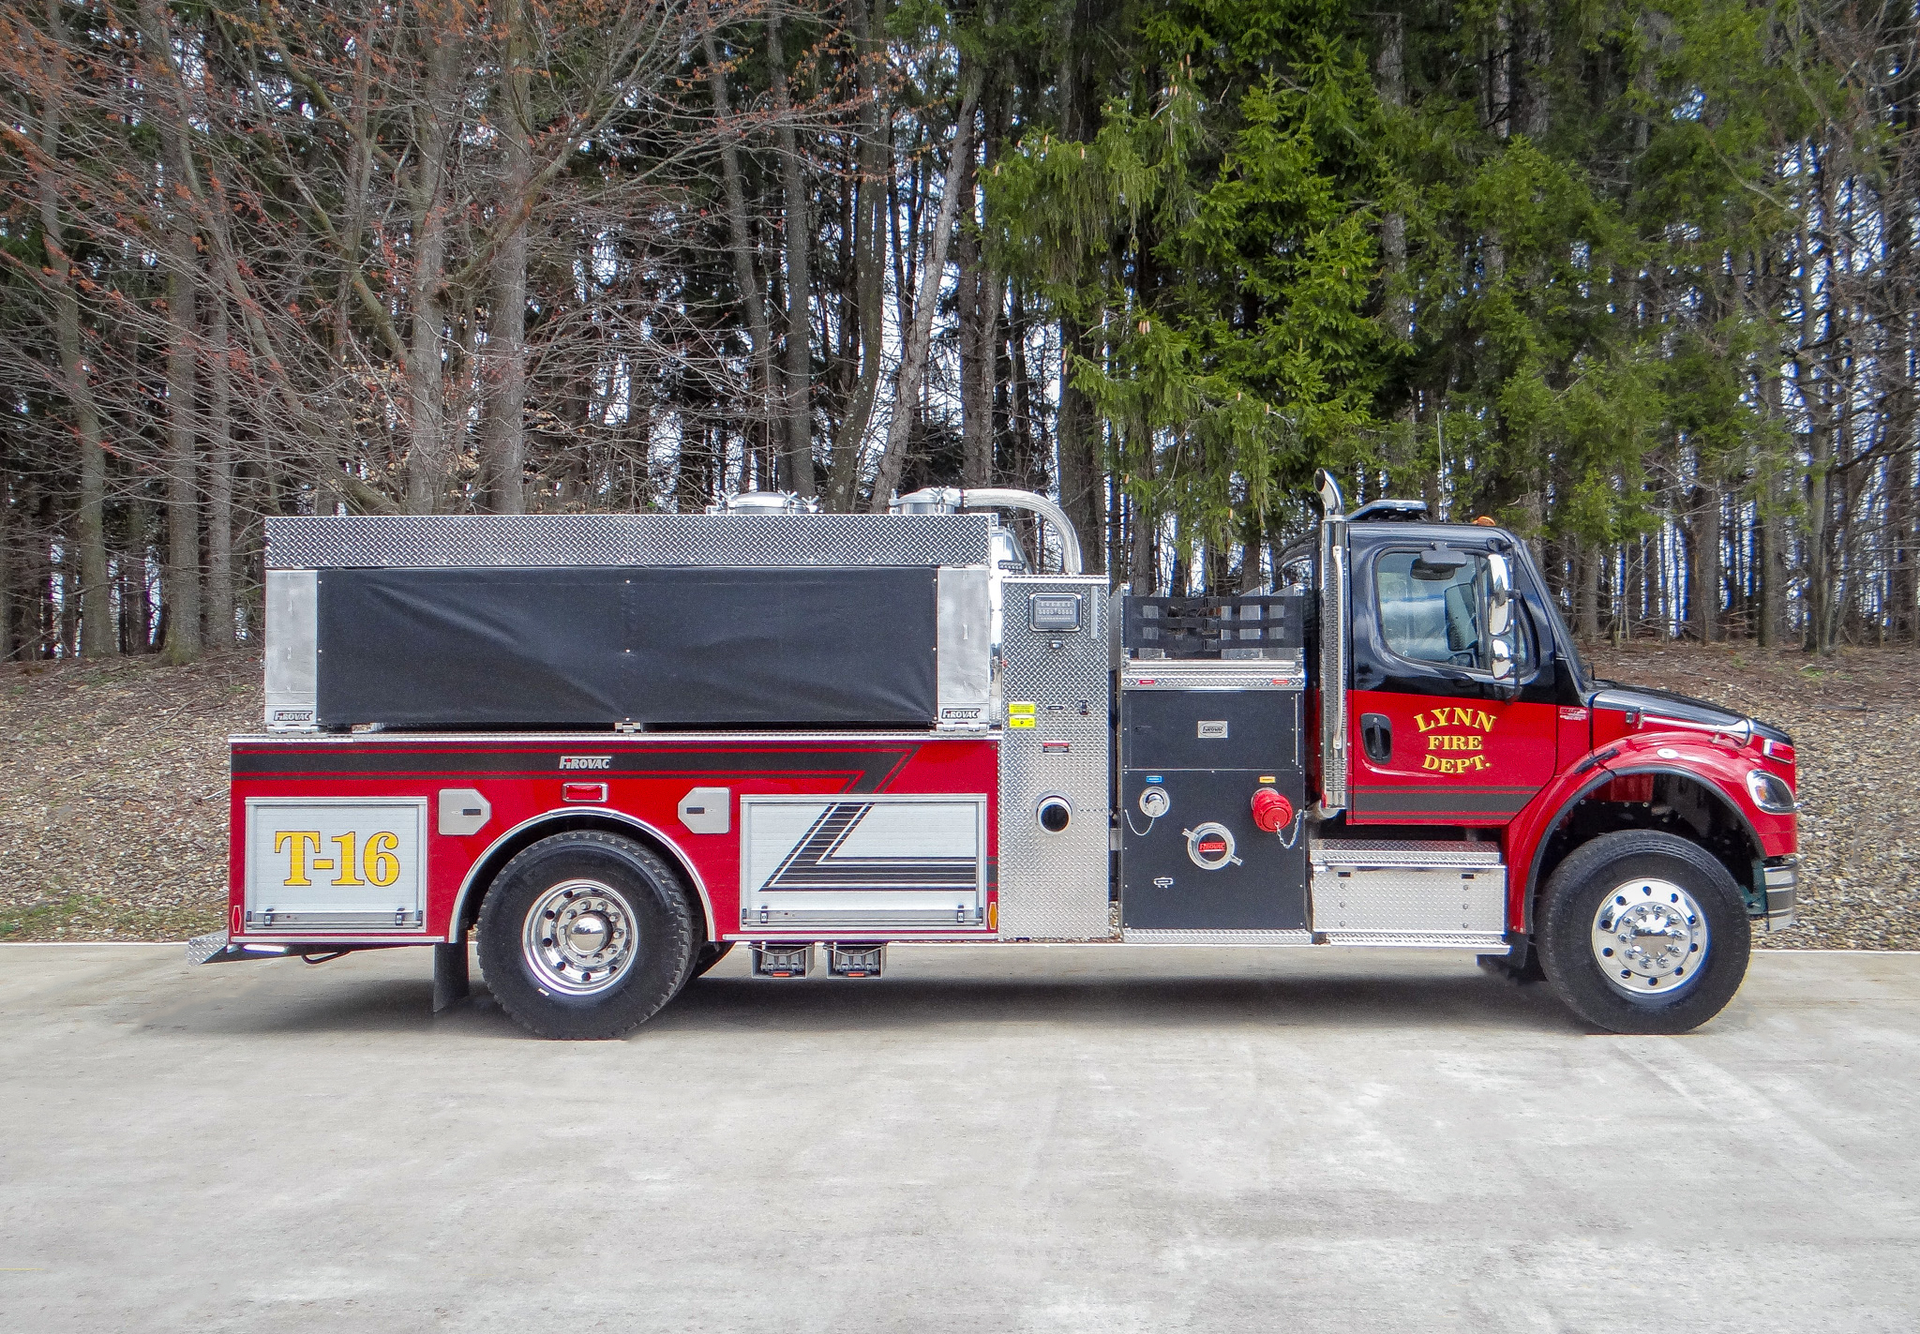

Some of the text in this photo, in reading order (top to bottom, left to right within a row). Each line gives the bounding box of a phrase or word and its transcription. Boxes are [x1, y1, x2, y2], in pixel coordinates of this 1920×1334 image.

[1413, 707, 1497, 733] LYNN
[1427, 735, 1483, 750] FIRE
[1421, 754, 1491, 774] DEPT.
[274, 830, 400, 887] T-16
